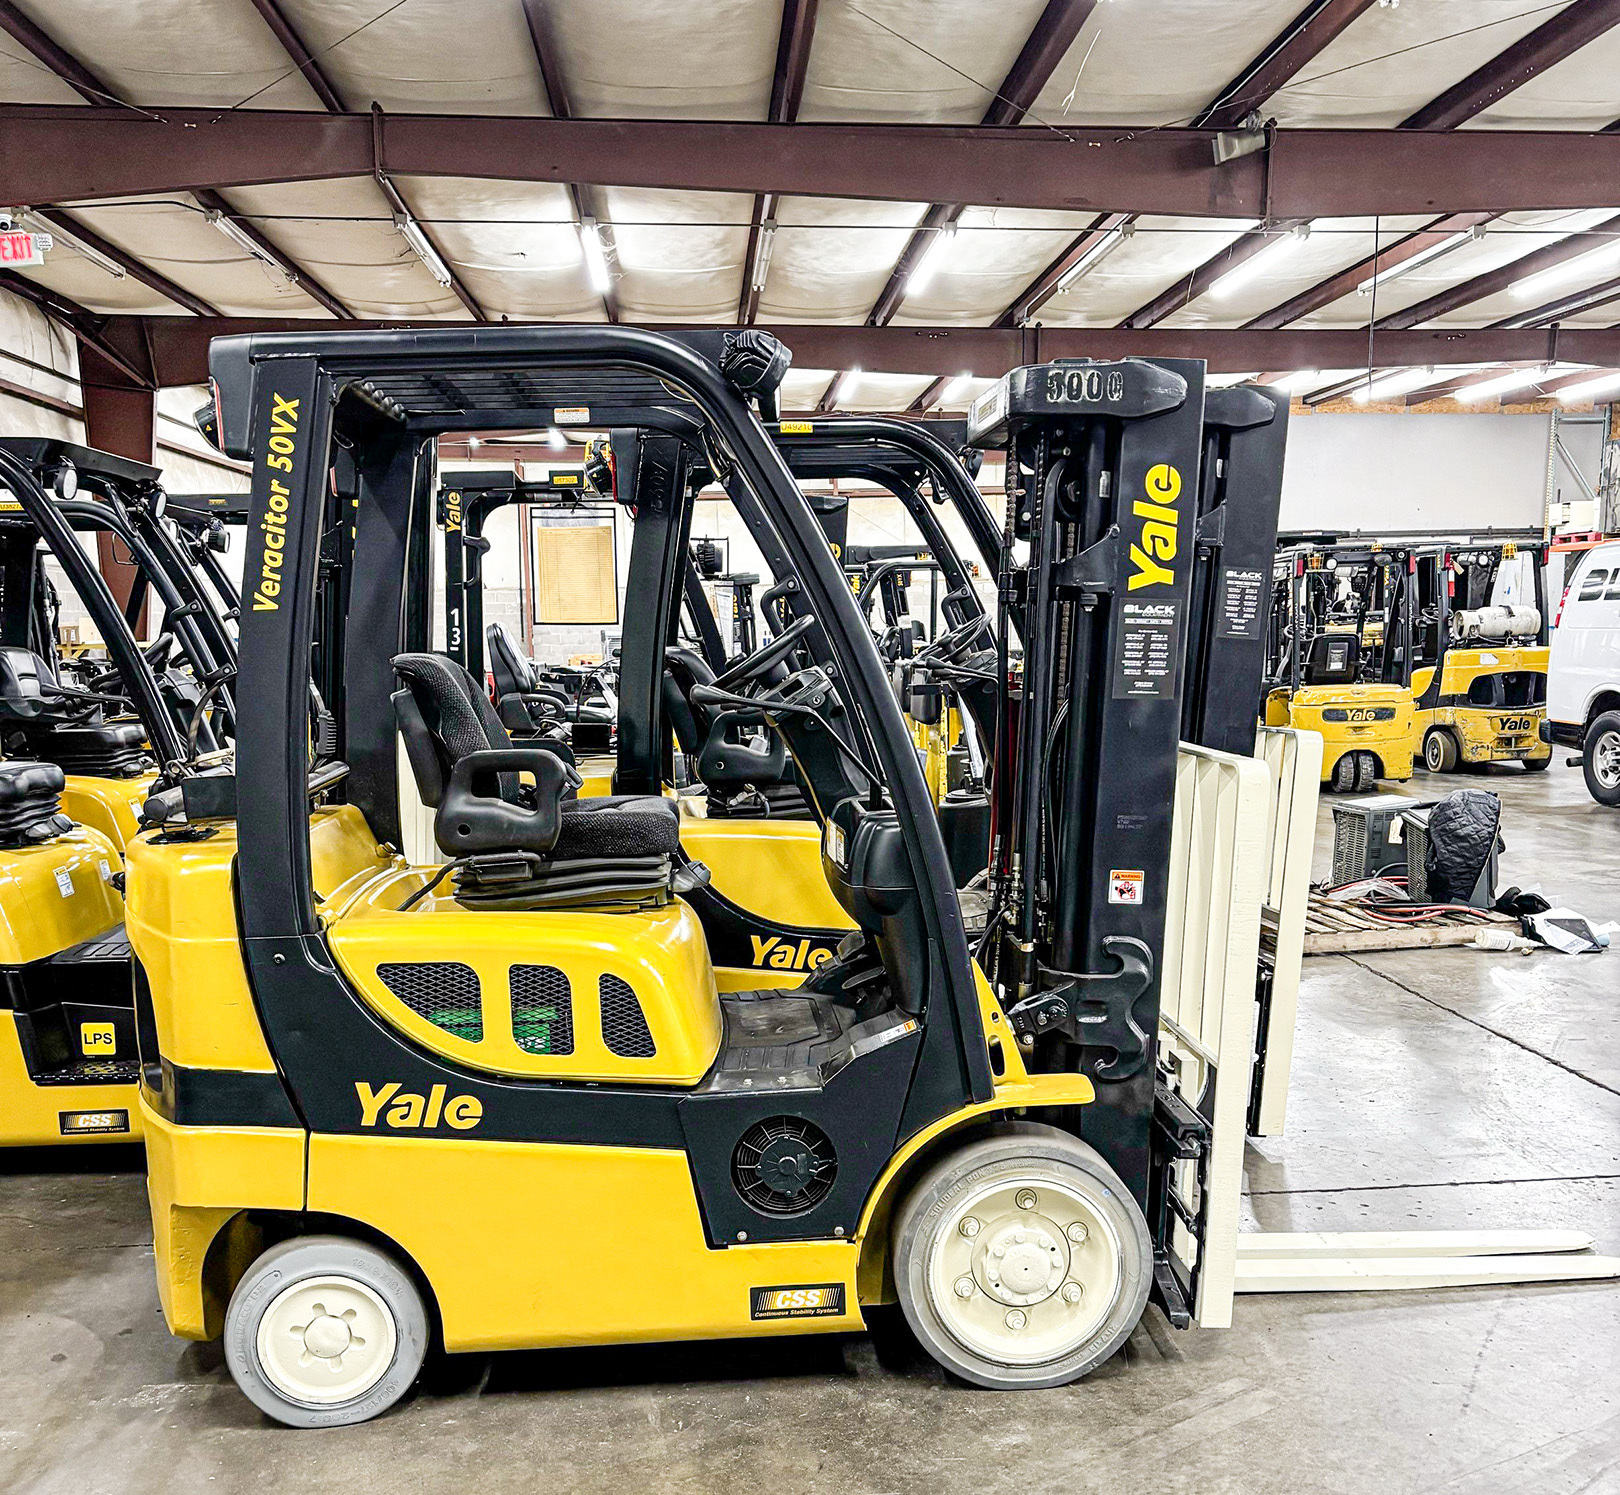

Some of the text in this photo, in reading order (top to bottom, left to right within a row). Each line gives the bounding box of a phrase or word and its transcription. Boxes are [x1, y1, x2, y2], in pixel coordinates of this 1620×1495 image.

[0, 235, 31, 260] EXIT
[252, 391, 300, 611] Veracitor 50VX
[445, 491, 461, 533] Yale
[1127, 463, 1182, 592] Yale
[1226, 570, 1263, 580] BLACK
[1123, 604, 1176, 615] BLACK
[1345, 708, 1376, 722] Yale
[1499, 717, 1531, 731] Yale
[750, 934, 834, 971] Yale
[83, 1032, 113, 1045] LPS
[354, 1081, 484, 1130] Yale
[78, 1114, 112, 1128] CSS
[776, 1289, 821, 1308] CSS
[754, 1310, 789, 1318] Continuous
[789, 1308, 815, 1316] Stability
